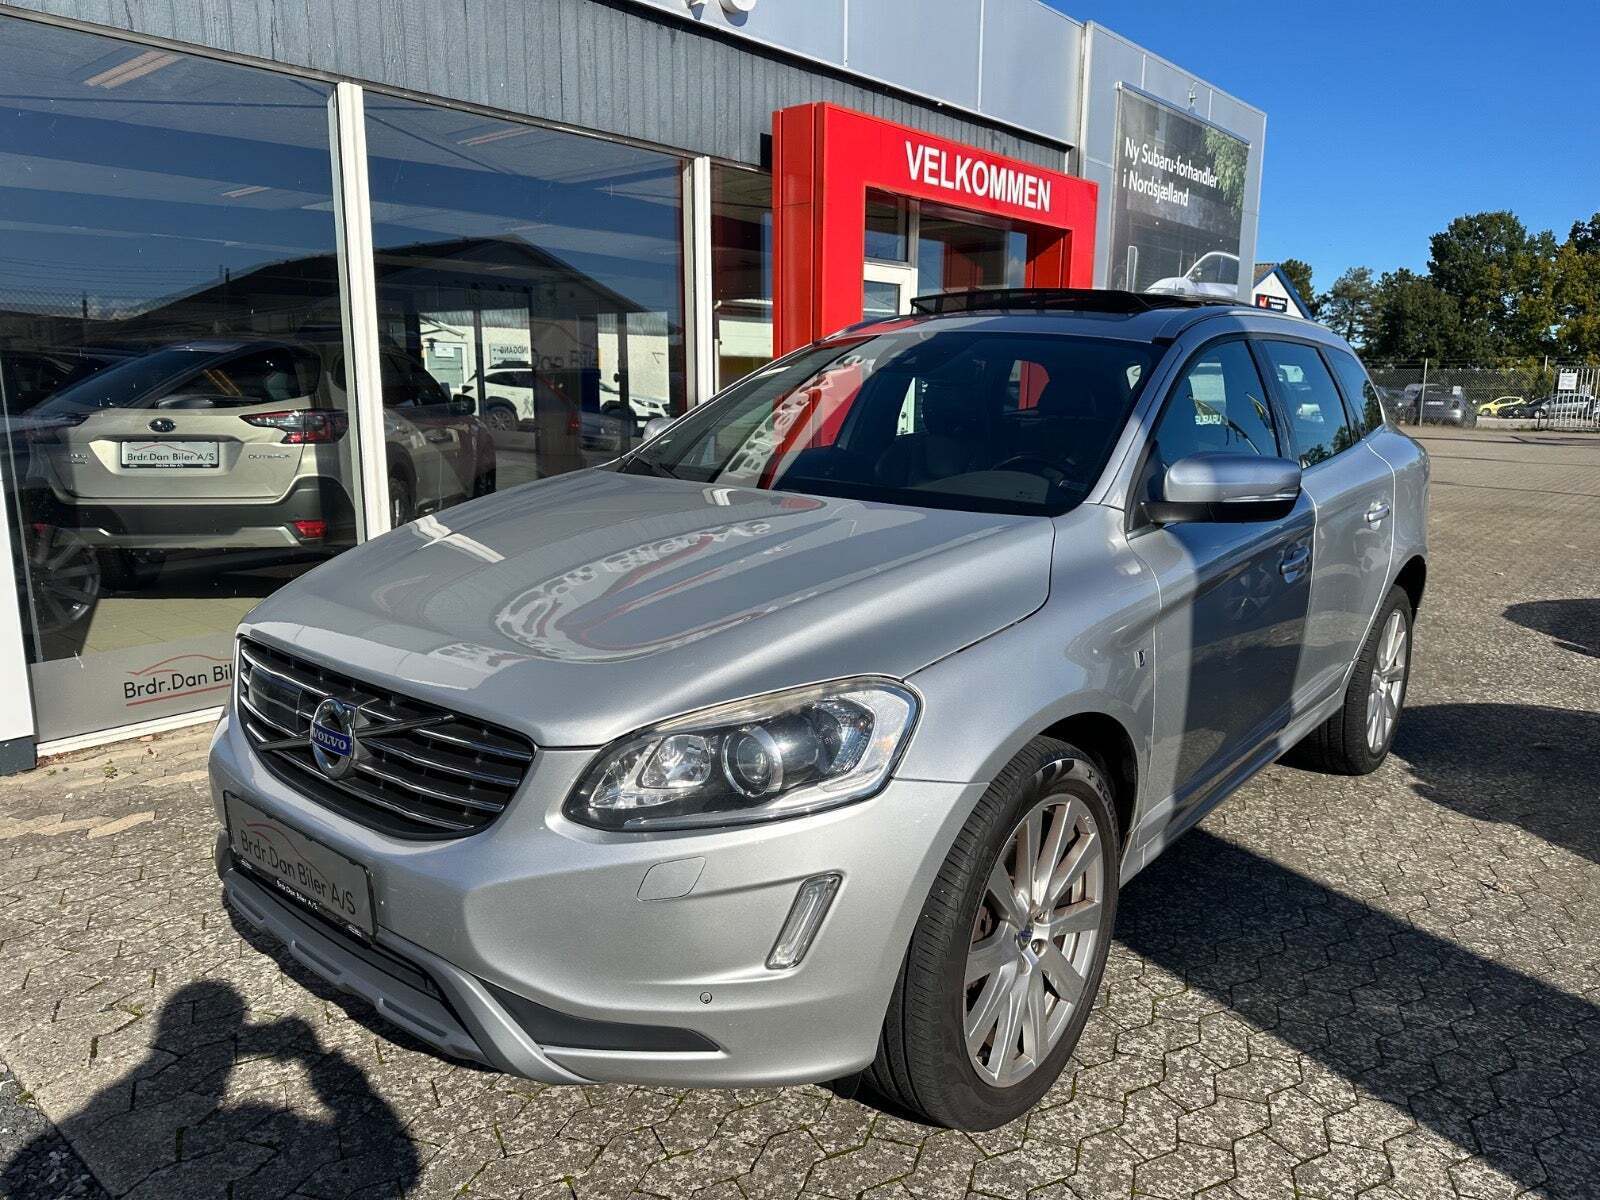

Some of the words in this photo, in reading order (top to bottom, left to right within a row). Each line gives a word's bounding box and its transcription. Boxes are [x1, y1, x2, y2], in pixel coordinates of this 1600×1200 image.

[904, 140, 1051, 213] VELKOMMEN
[1125, 137, 1140, 166] Ny
[1141, 143, 1218, 188] Subaru-forhandler
[1122, 168, 1127, 188] i
[1128, 170, 1189, 207] Nordsjælland
[127, 453, 169, 461] Brdr.Dan
[173, 453, 194, 461] Biler
[197, 453, 215, 461] A/S
[123, 673, 208, 699] Brdr.Dan
[312, 727, 347, 751] VOLVO
[241, 830, 296, 878] Brdr.Dan
[297, 861, 327, 898] Biler
[331, 882, 356, 915] A/S
